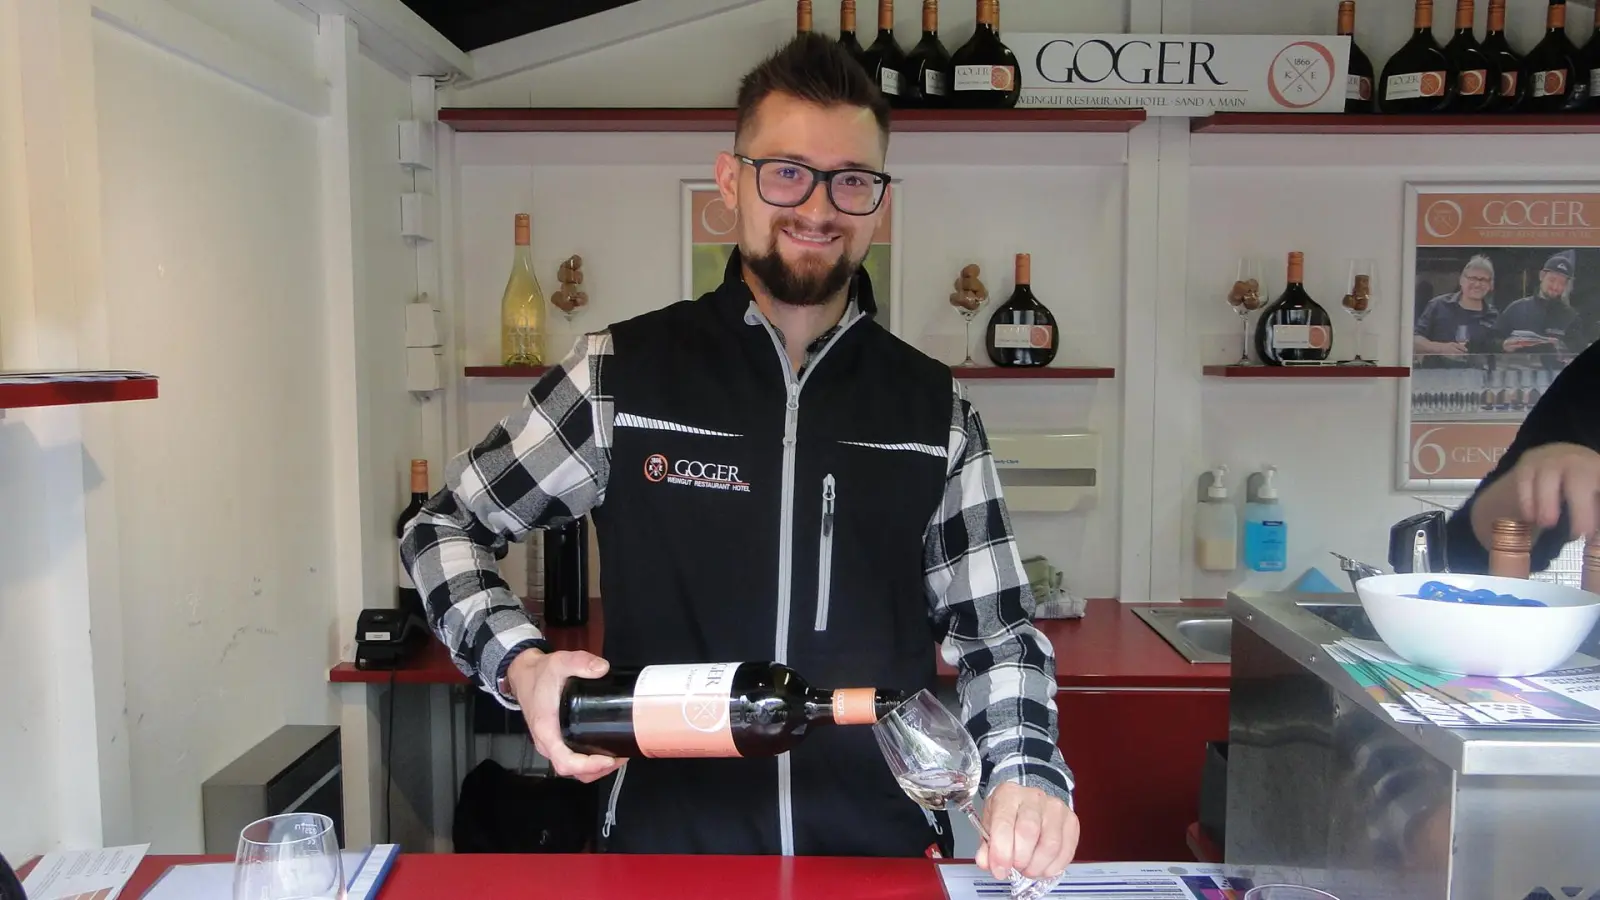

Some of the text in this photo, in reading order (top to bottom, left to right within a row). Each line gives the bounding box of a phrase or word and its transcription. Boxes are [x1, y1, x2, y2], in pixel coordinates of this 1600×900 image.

[1036, 39, 1228, 85] GOGER
[1294, 58, 1311, 66] 1866
[1284, 71, 1317, 80] K E
[1296, 85, 1303, 93] S
[1016, 95, 1062, 105] WEINGUT
[1066, 95, 1131, 106] RESTAURANT
[1135, 96, 1166, 107] HOTEL
[1174, 97, 1204, 107] SAND
[1218, 97, 1246, 107] MAIN
[1482, 199, 1591, 227] GOGER
[1412, 427, 1446, 475] 6
[675, 459, 742, 482] GOGER
[667, 477, 692, 486] WEINGUT
[694, 480, 731, 491] RESTAURANT
